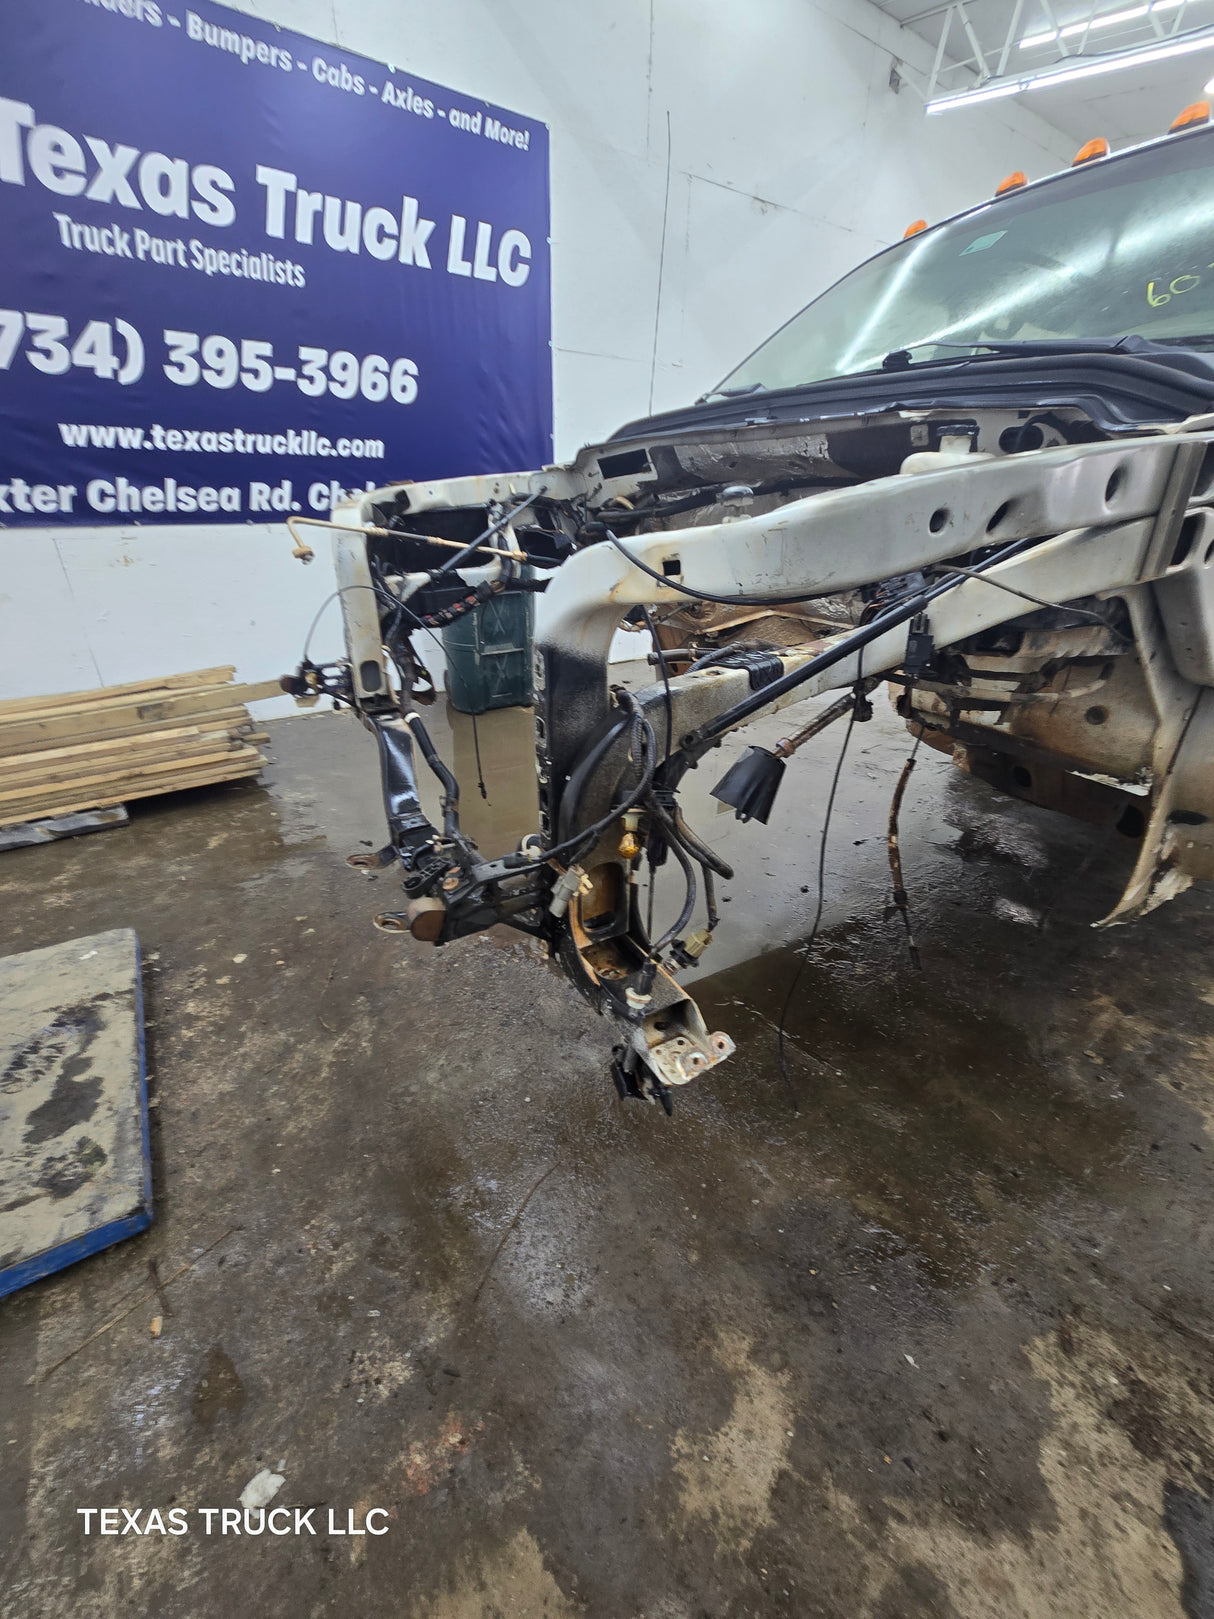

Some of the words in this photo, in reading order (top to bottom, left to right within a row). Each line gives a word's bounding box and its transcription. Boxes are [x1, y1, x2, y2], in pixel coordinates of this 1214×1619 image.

[83, 0, 163, 27] ers
[186, 9, 293, 72] Bumpers
[312, 57, 365, 95] Cabs
[381, 81, 434, 118] Axles
[449, 108, 482, 136] and
[485, 117, 530, 150] More!
[0, 97, 236, 227] Texas
[256, 164, 436, 269] Truck
[447, 214, 532, 287] LLC
[52, 211, 134, 259] Truck
[133, 227, 189, 268] Part
[189, 239, 306, 288] Specialists
[1147, 262, 1214, 307] 60
[162, 329, 419, 405] 395-3966
[57, 423, 385, 459] www.texastruckllc.com
[86, 477, 241, 514] Chelsea
[249, 479, 302, 512] Rd.
